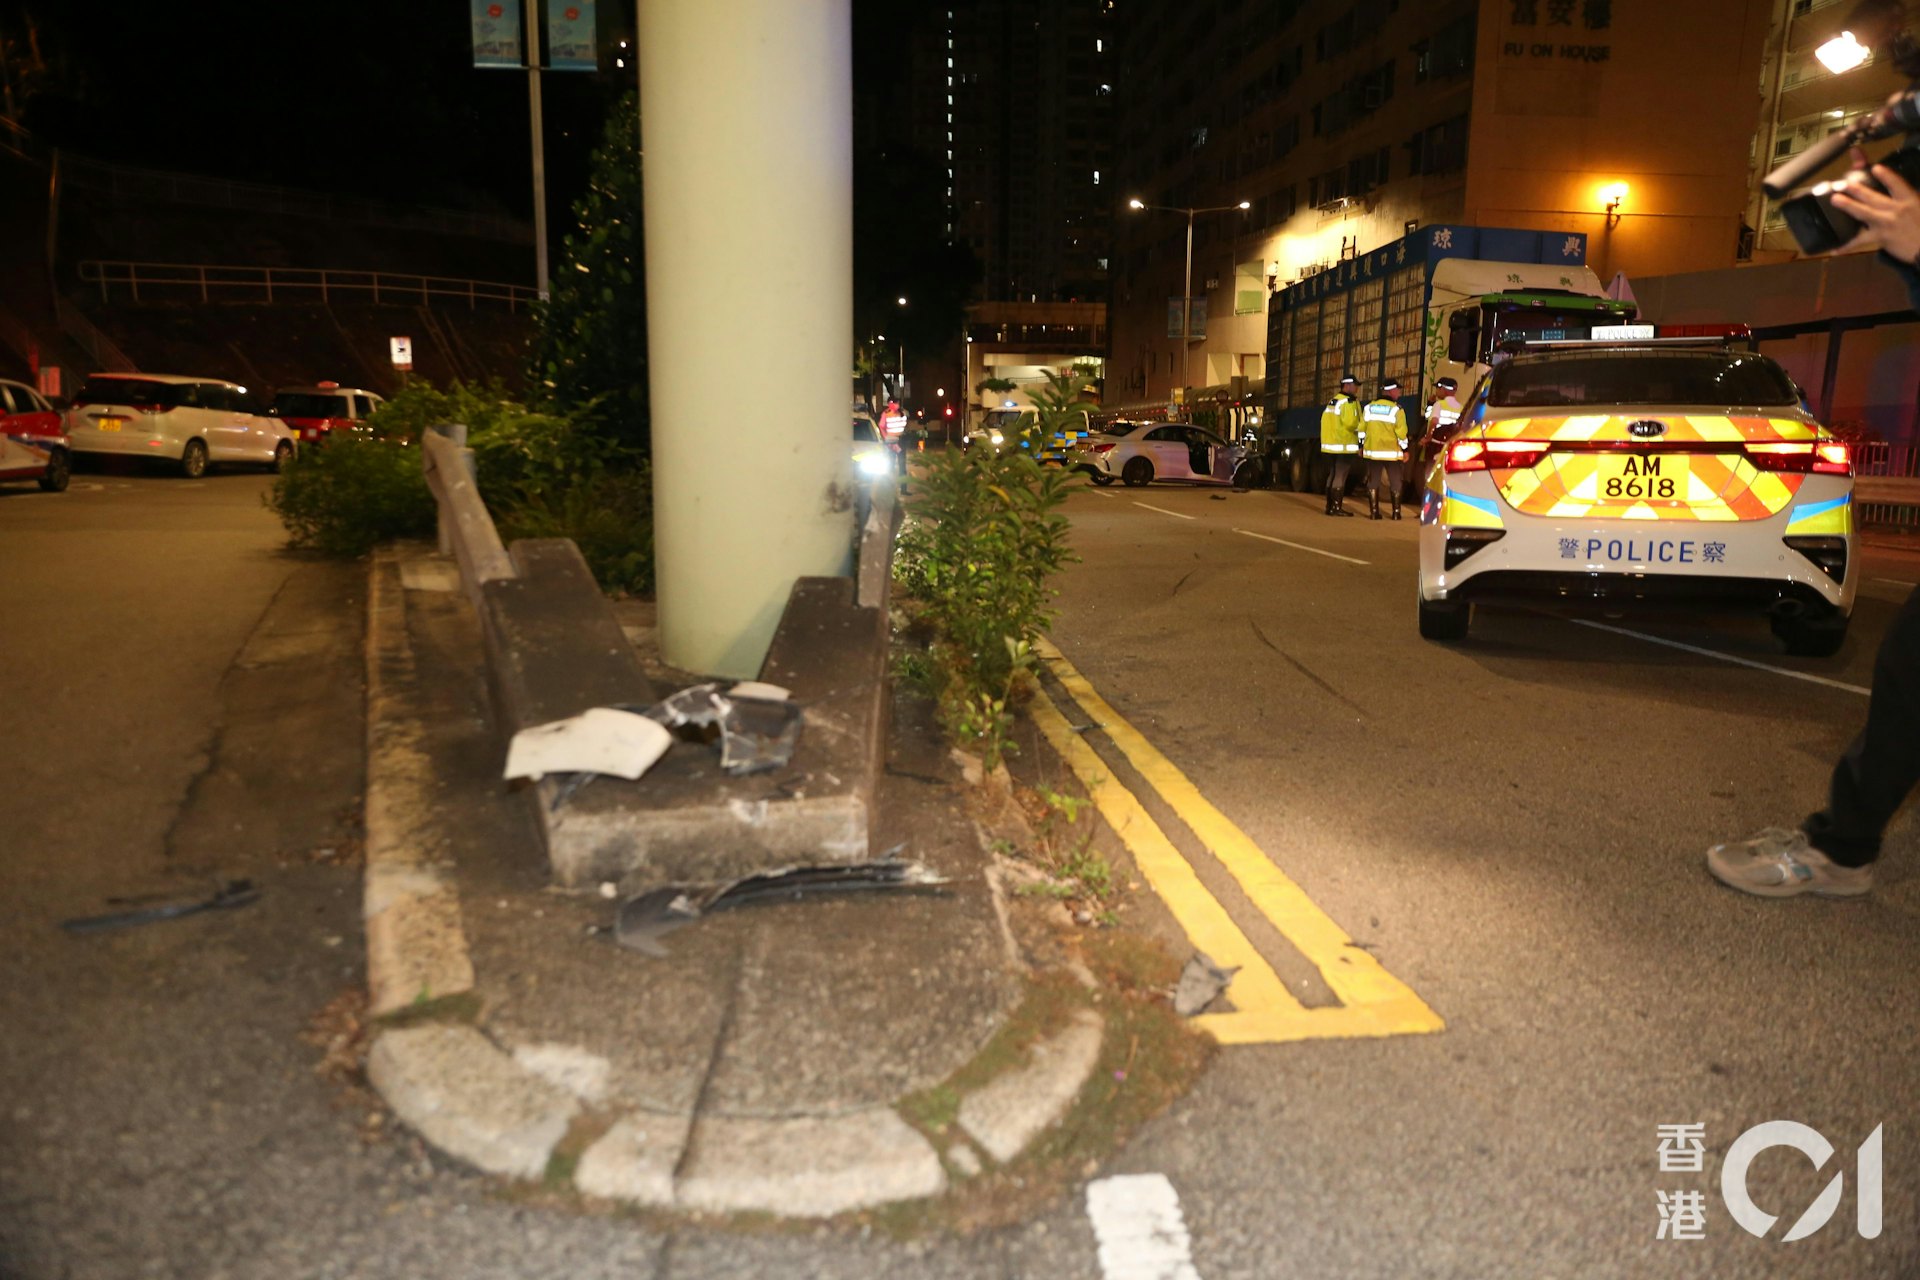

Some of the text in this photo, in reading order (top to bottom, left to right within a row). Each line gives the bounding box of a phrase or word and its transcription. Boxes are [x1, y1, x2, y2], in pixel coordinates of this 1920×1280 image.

[1504, 42, 1611, 62] FU ON HOUSE
[1623, 456, 1661, 476] AM
[1606, 477, 1675, 498] 8618
[1558, 538, 1727, 563] 警 POLICE 察
